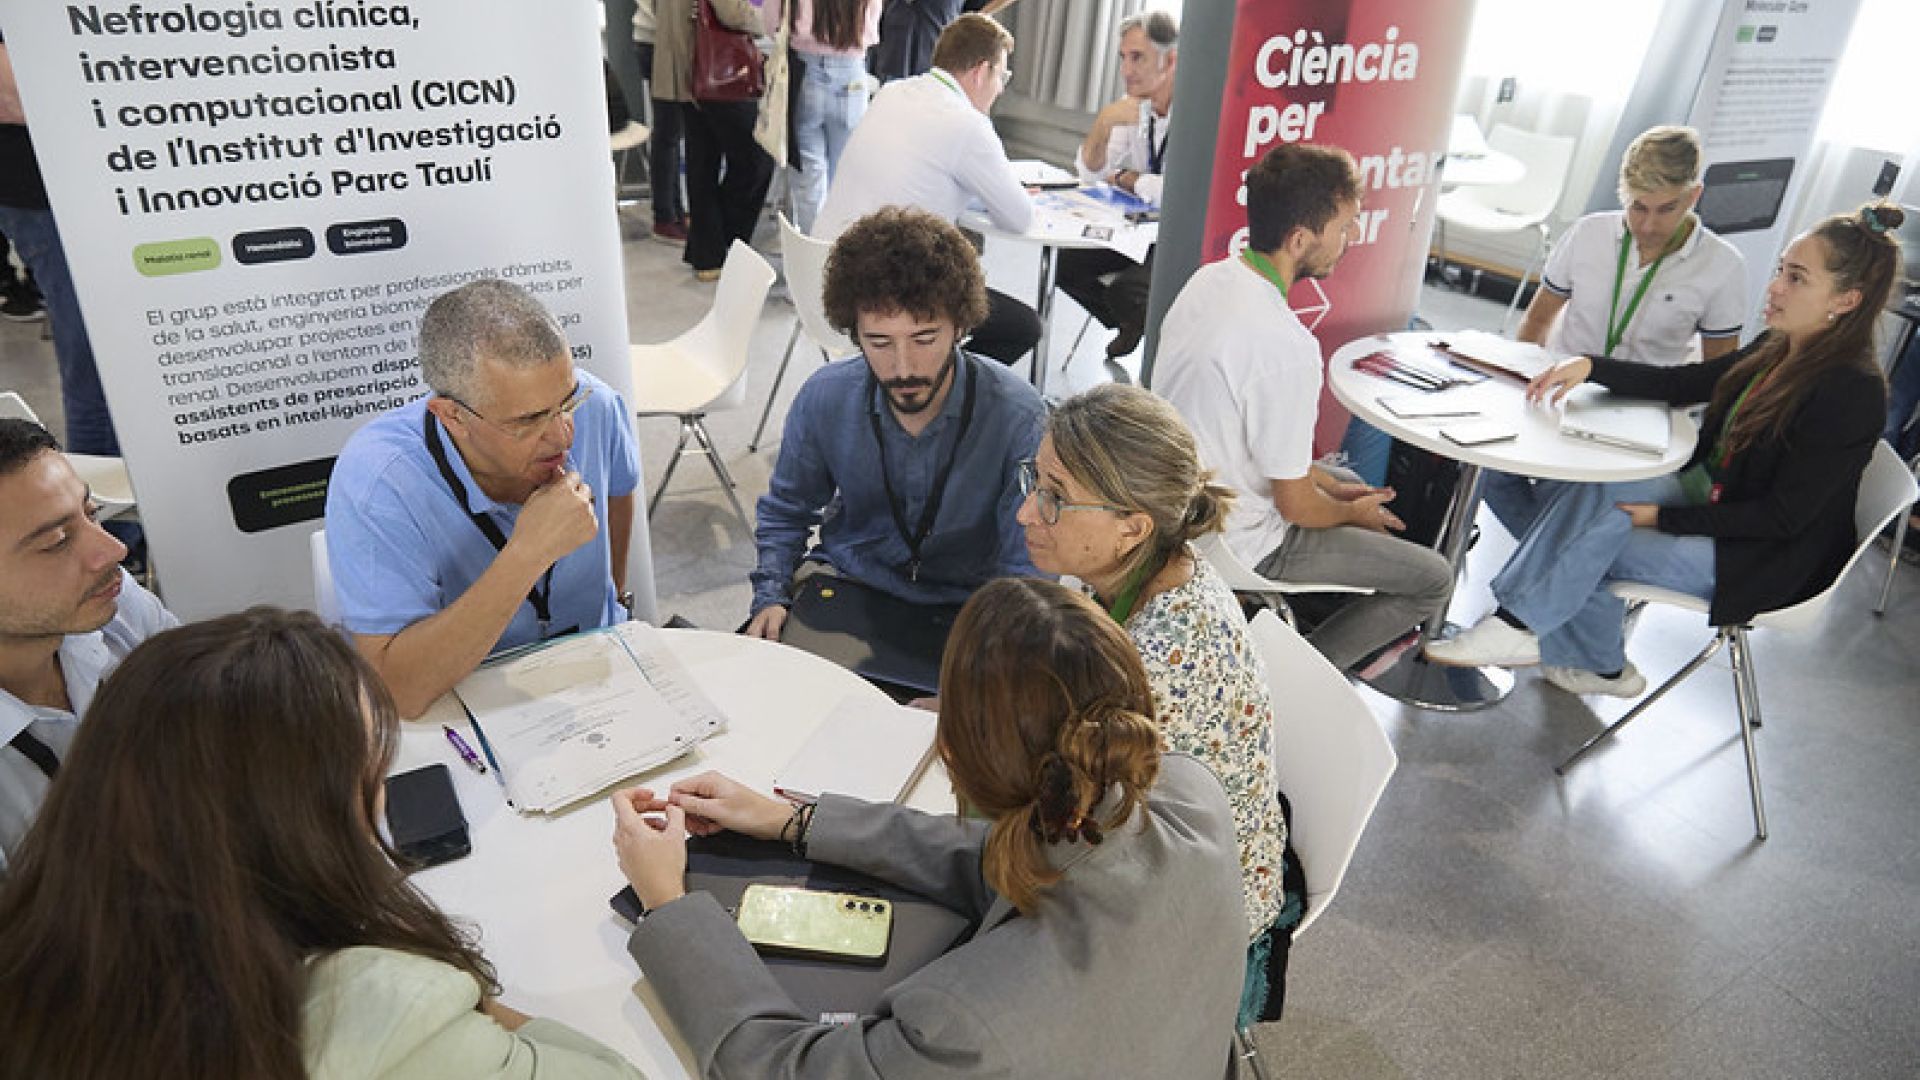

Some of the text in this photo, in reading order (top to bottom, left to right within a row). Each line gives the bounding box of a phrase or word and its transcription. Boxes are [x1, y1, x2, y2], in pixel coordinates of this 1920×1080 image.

[68, 0, 420, 36] Nefrologia clínica,
[80, 44, 397, 83] intervencionista
[1255, 25, 1418, 88] Ciència
[93, 76, 516, 128] i computacional (CICN)
[107, 114, 562, 173] de l'Institut d'Investigació
[1244, 100, 1325, 158] per
[115, 156, 493, 216] i Innovació Parc Taulí
[146, 258, 573, 327] El grup està integrat per professionals d'àmbits
[152, 329, 181, 347] de
[184, 326, 205, 342] la
[208, 318, 264, 339] salut,
[268, 304, 369, 332] enginyeria
[557, 276, 584, 292] per
[157, 337, 294, 367] desenvolupar
[299, 322, 386, 348] projectes
[389, 318, 412, 334] en
[162, 353, 291, 385] translacional
[295, 353, 309, 366] a
[384, 336, 408, 353] de
[174, 397, 280, 426] assistents
[285, 392, 309, 407] de
[314, 372, 419, 404] prescripció
[226, 365, 368, 396] Desenvolupem
[177, 422, 251, 446] basats
[255, 414, 281, 432] en
